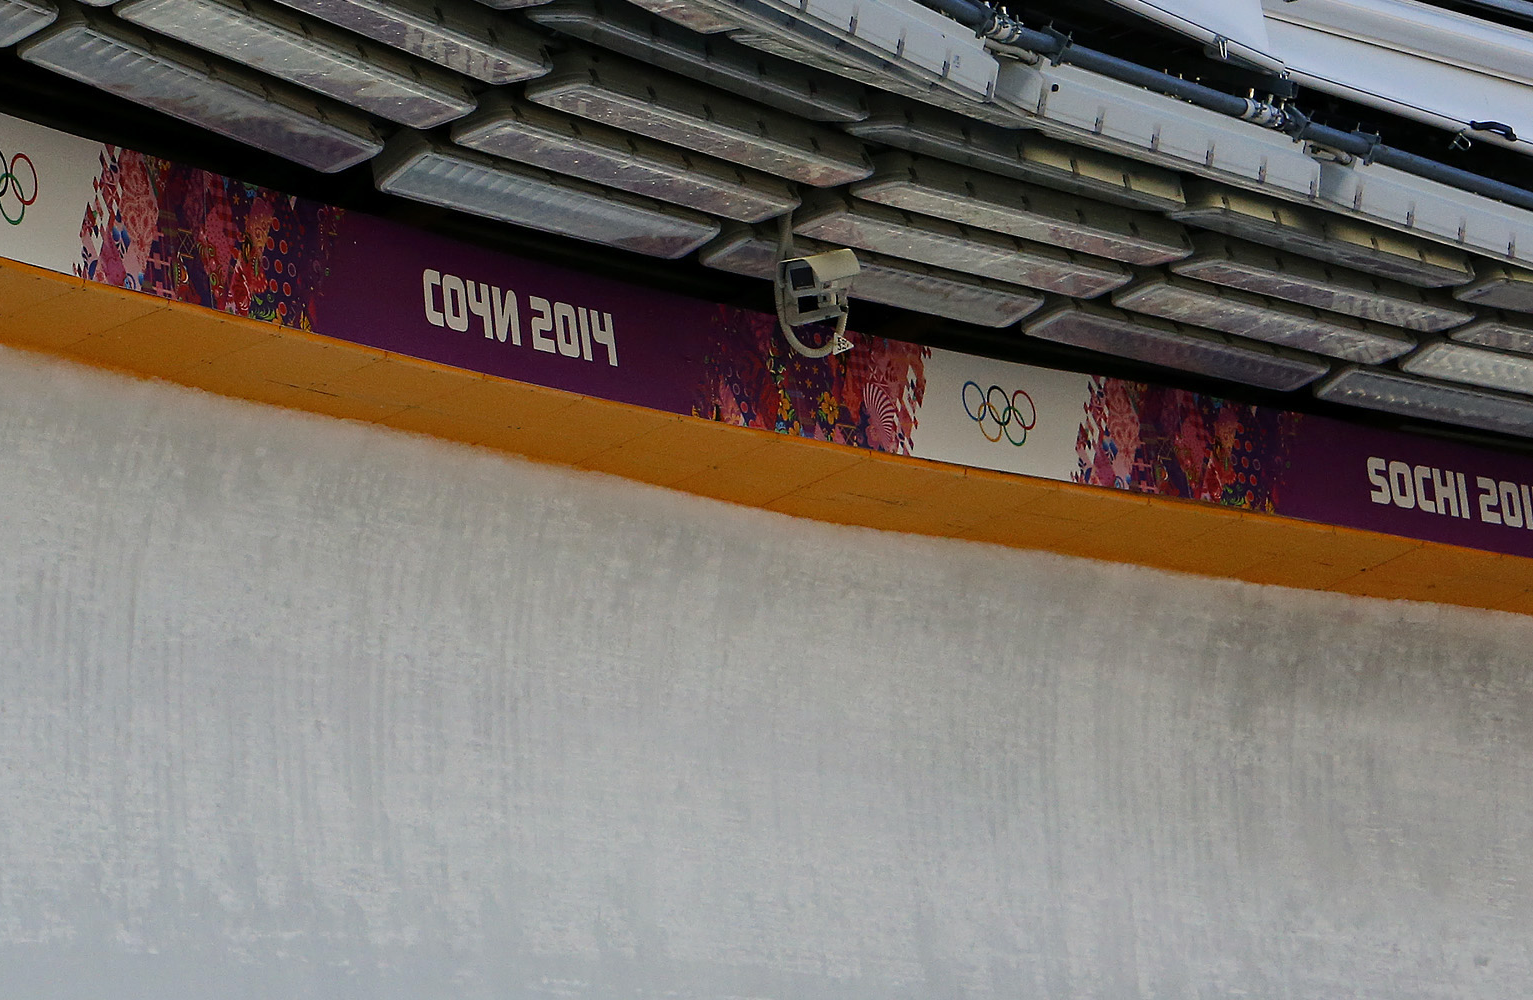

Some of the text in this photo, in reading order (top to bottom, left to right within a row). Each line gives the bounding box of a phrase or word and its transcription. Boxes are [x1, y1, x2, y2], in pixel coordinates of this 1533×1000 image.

[423, 269, 618, 367] СОЧИ 2014
[1366, 456, 1533, 531] SOCHI 201
